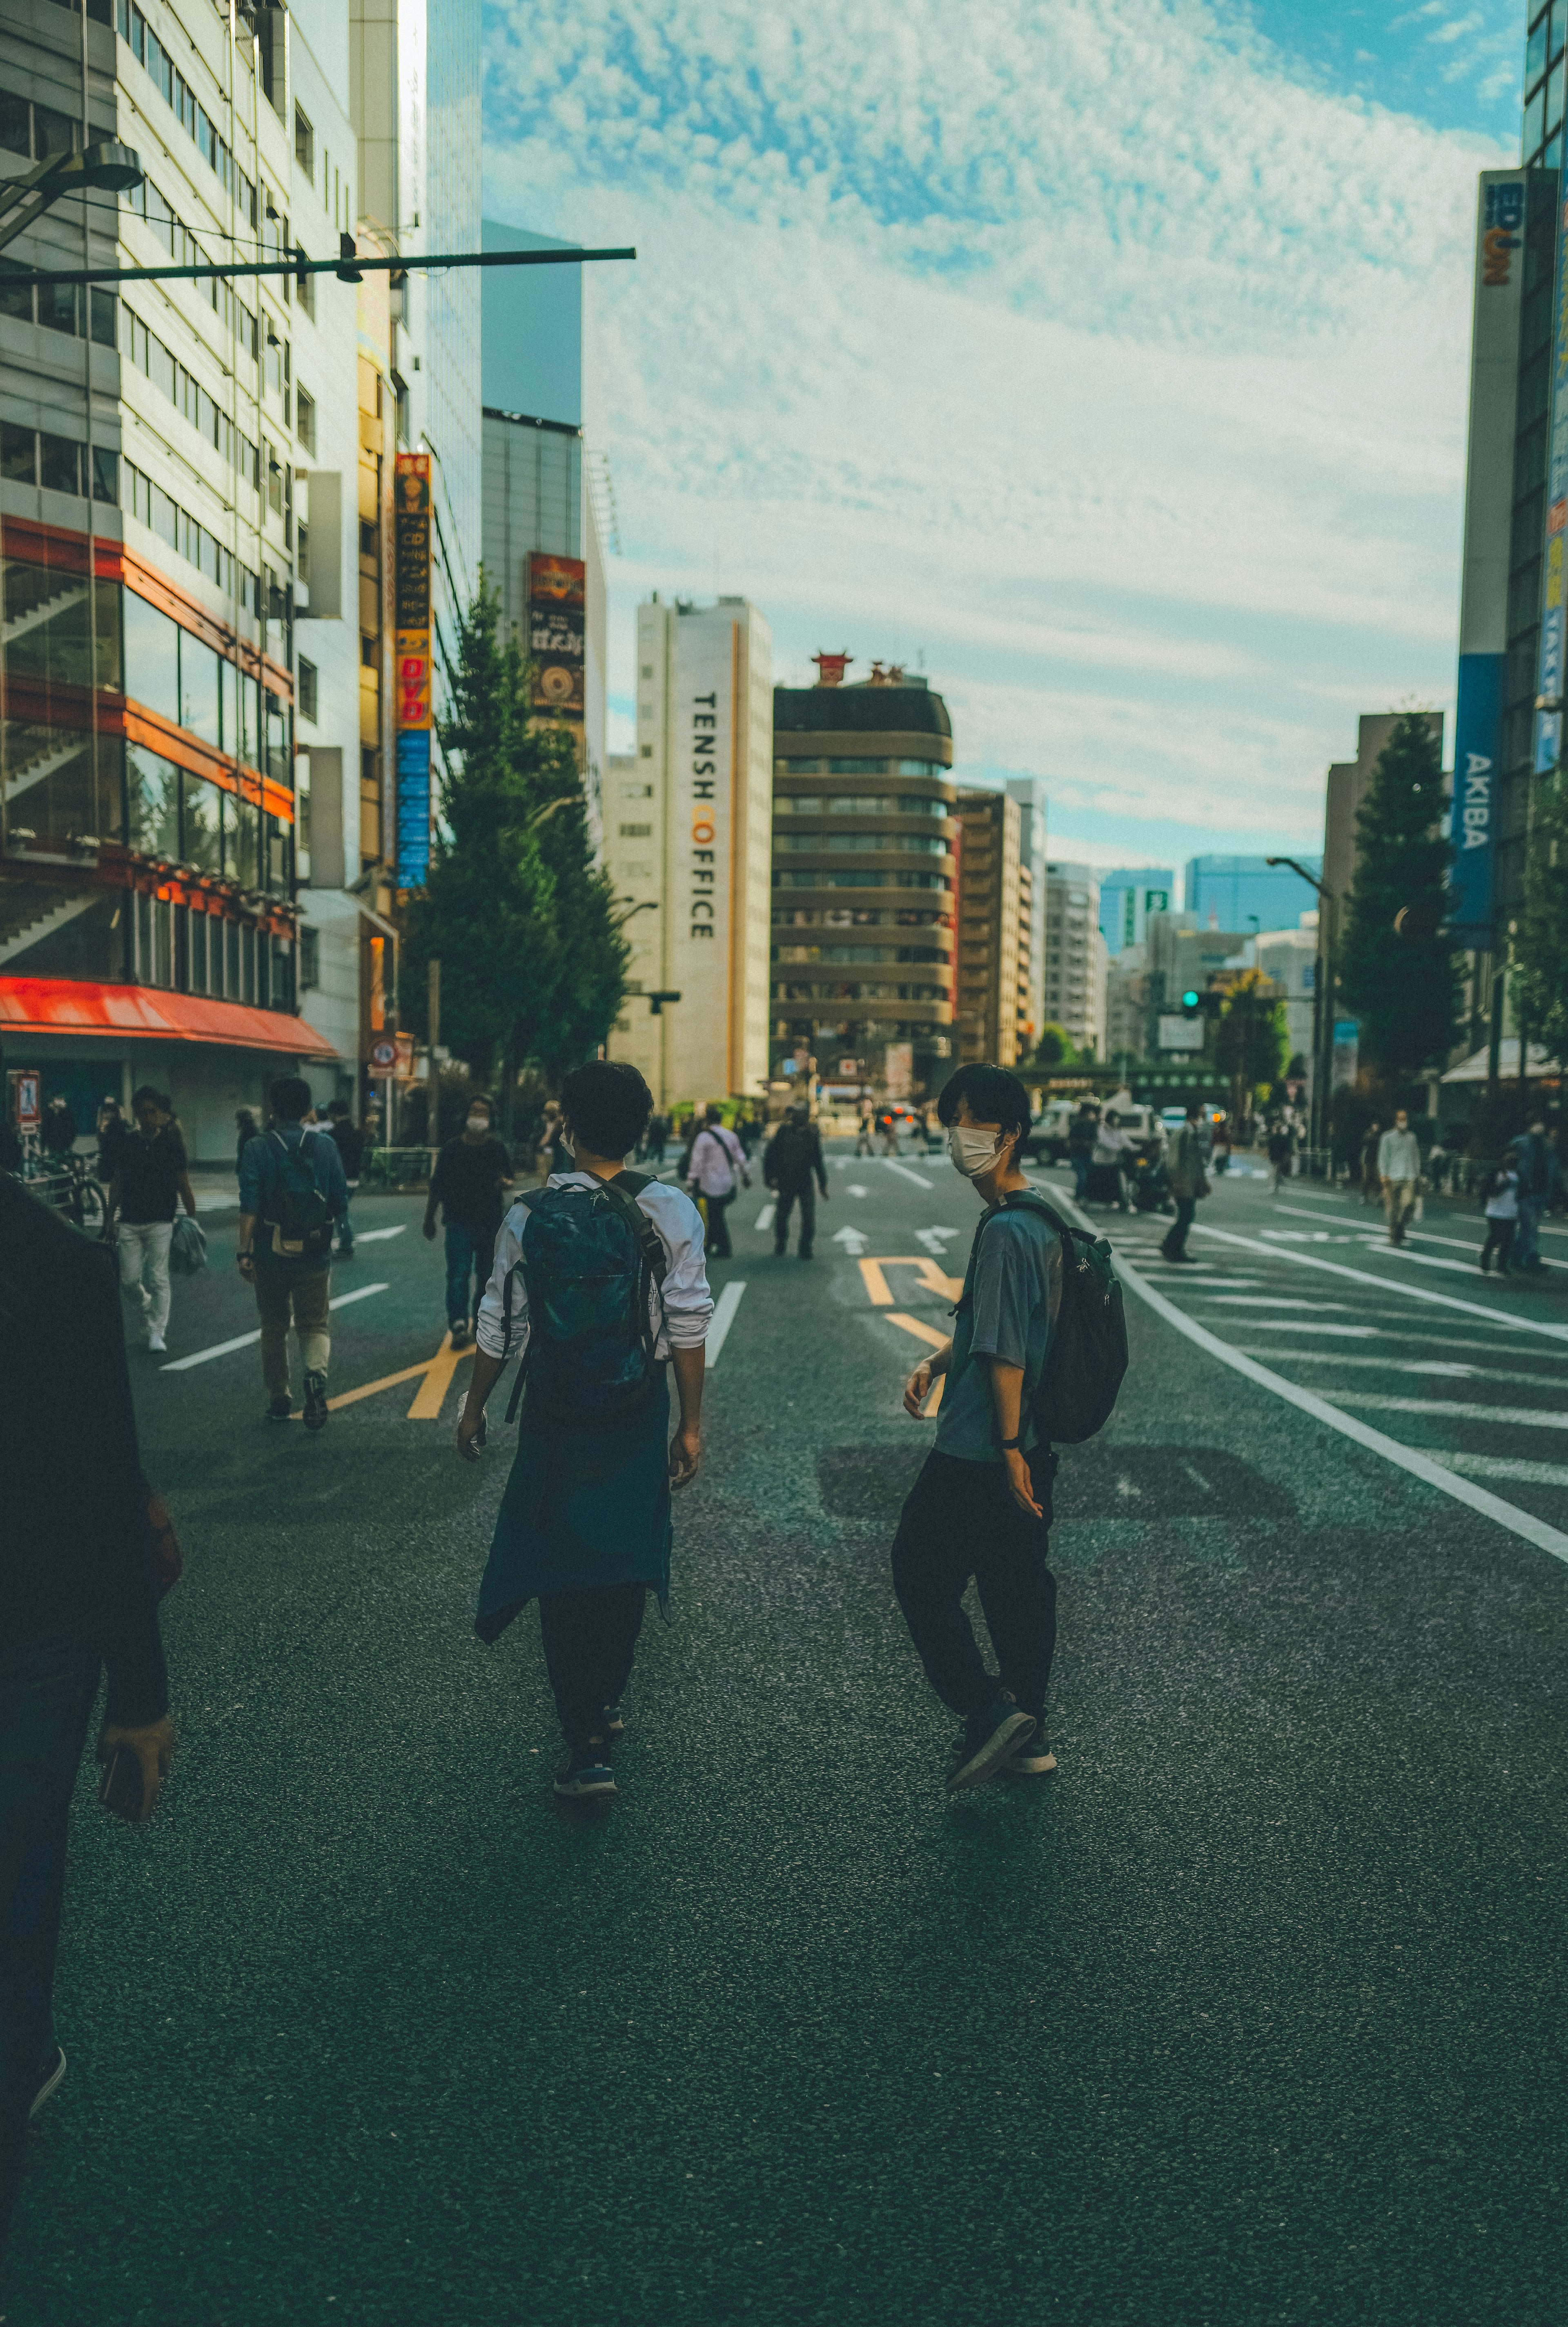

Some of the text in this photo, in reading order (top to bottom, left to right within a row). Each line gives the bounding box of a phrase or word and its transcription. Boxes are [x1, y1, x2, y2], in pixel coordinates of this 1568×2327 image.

[401, 658, 425, 721] DVD
[691, 691, 717, 938] TENSHO OFFICE
[1463, 752, 1492, 850] AKIBA
